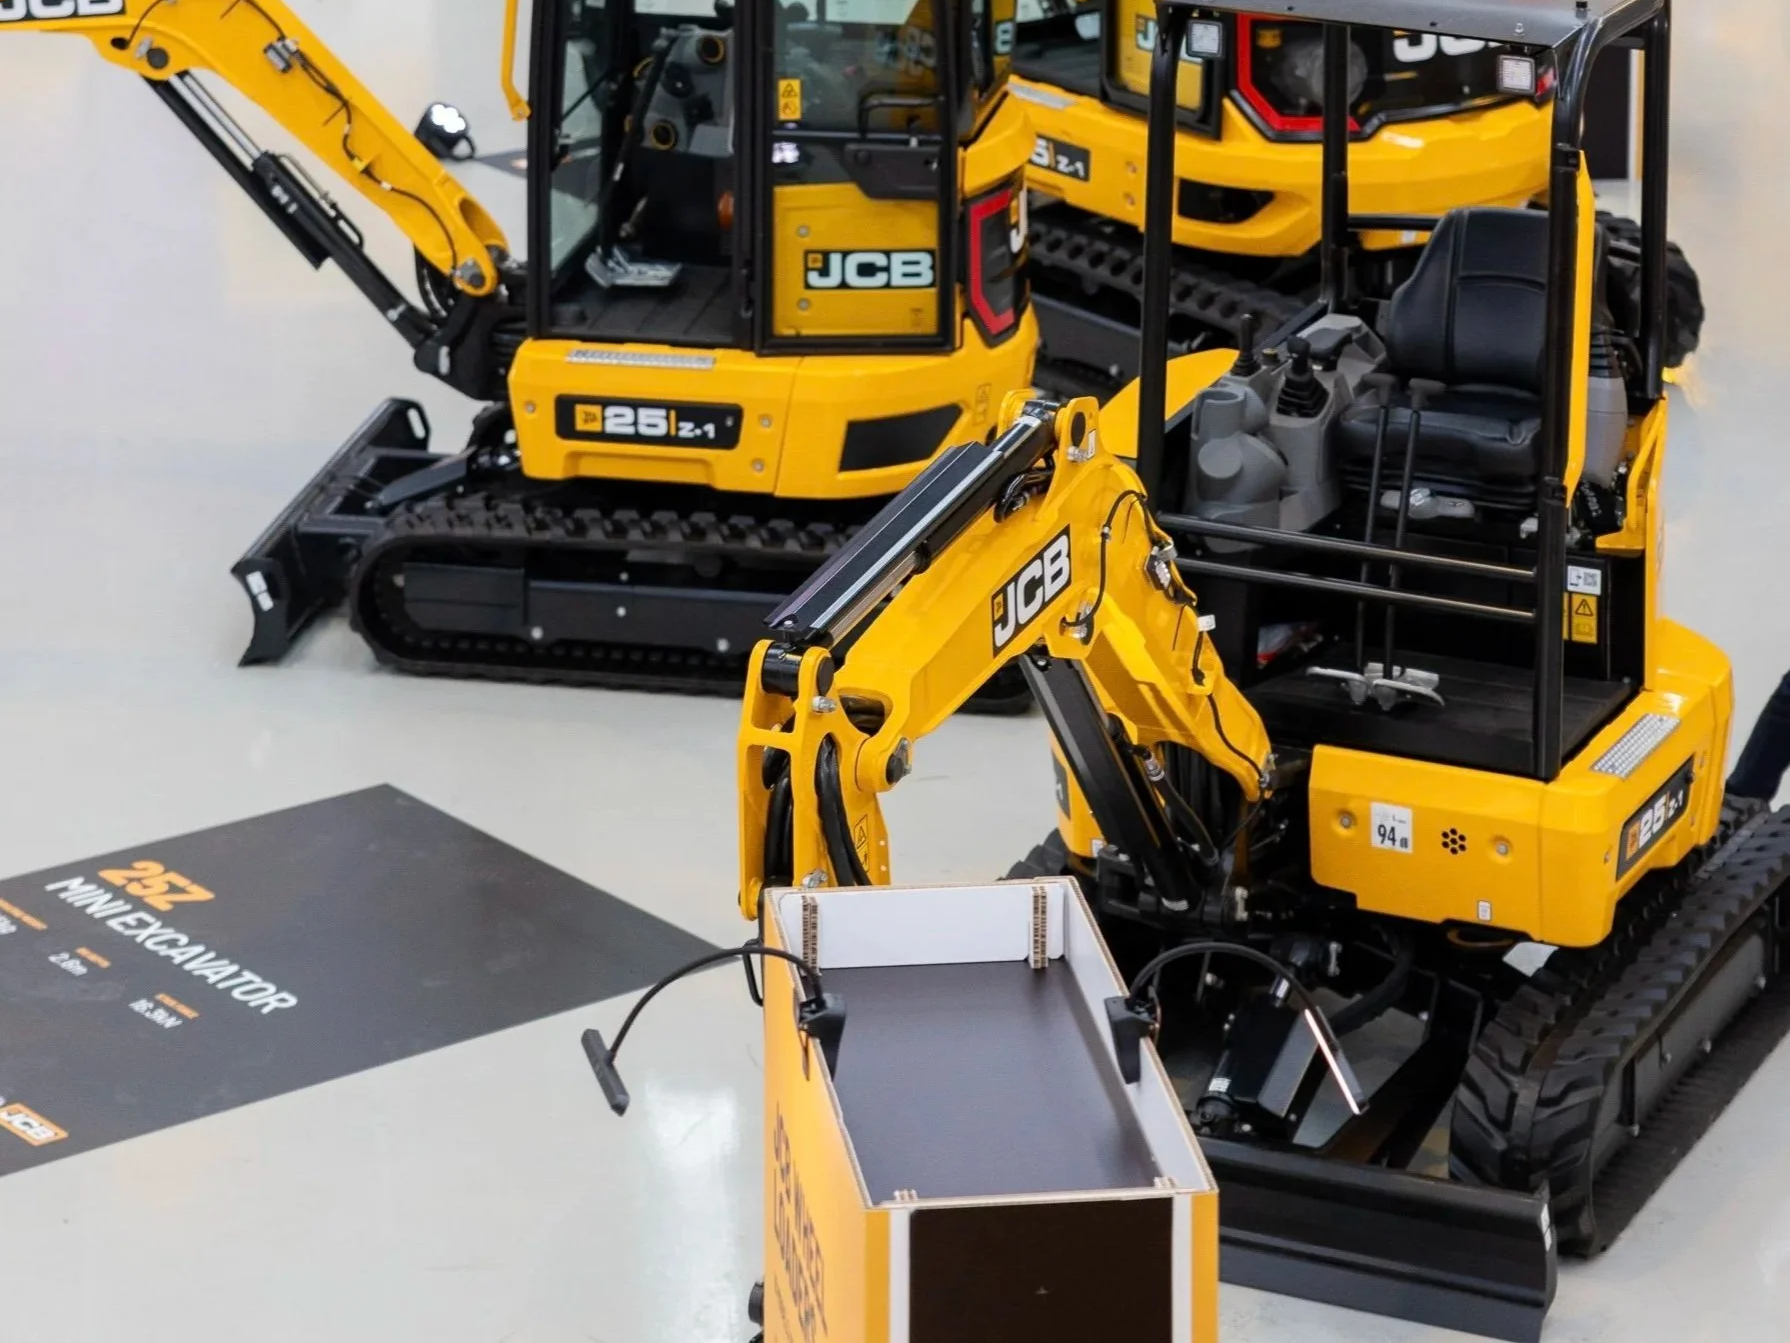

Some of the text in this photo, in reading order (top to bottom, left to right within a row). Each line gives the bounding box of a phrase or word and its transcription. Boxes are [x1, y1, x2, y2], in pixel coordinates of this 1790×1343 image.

[806, 251, 934, 288] JCB
[994, 534, 1070, 648] JCB
[1377, 823, 1397, 846] 94
[97, 860, 216, 912] 25Z
[44, 875, 133, 919] MINI
[105, 910, 299, 1015] EXCAVATOR
